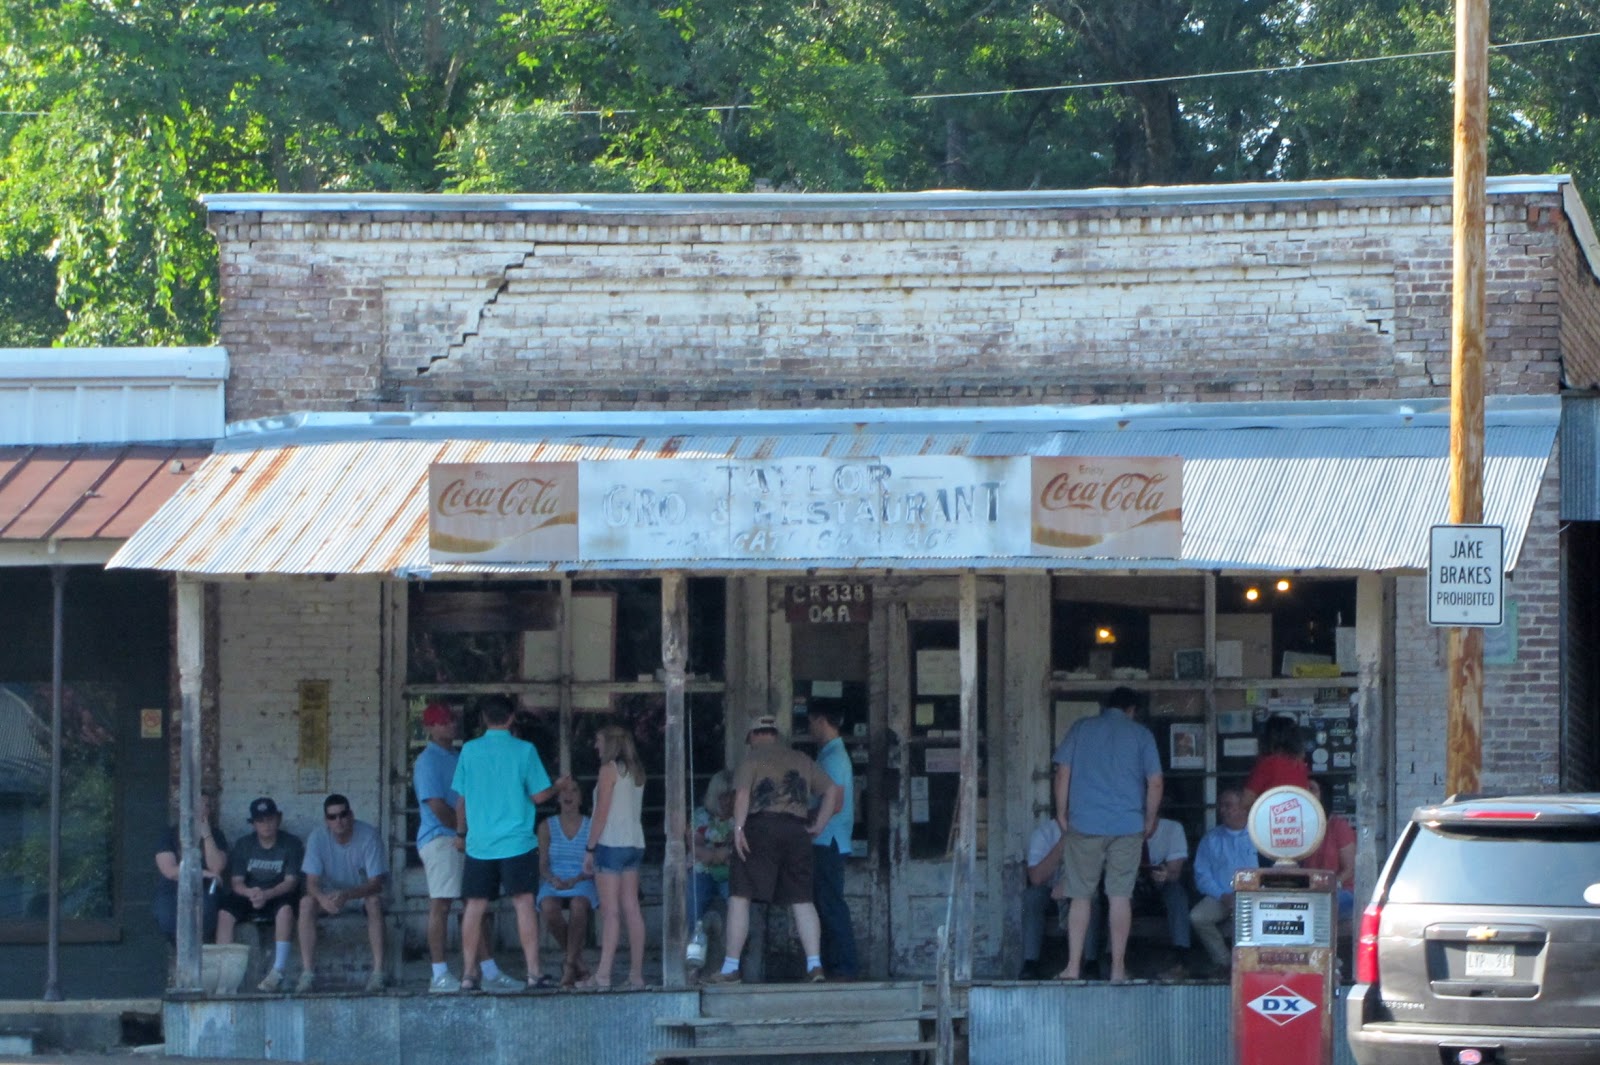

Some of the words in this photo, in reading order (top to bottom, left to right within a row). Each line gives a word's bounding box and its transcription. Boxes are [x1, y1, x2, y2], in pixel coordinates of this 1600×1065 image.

[1079, 465, 1104, 475] Enjoy
[715, 463, 893, 497] TAYLOR
[438, 477, 559, 517] Coca-Cola
[1040, 472, 1168, 512] Coca-Cola
[753, 480, 1006, 526] RESTAURANT
[1450, 540, 1484, 559] JAKE
[1440, 566, 1492, 585] BRAKES
[1436, 591, 1495, 606] PROHIBITED
[808, 604, 851, 623] 04A
[1273, 799, 1299, 815] OPEN
[1275, 816, 1285, 824] EAT
[1284, 827, 1301, 835] BOTH
[1275, 838, 1298, 847] STARVE
[1262, 998, 1301, 1011] DX
